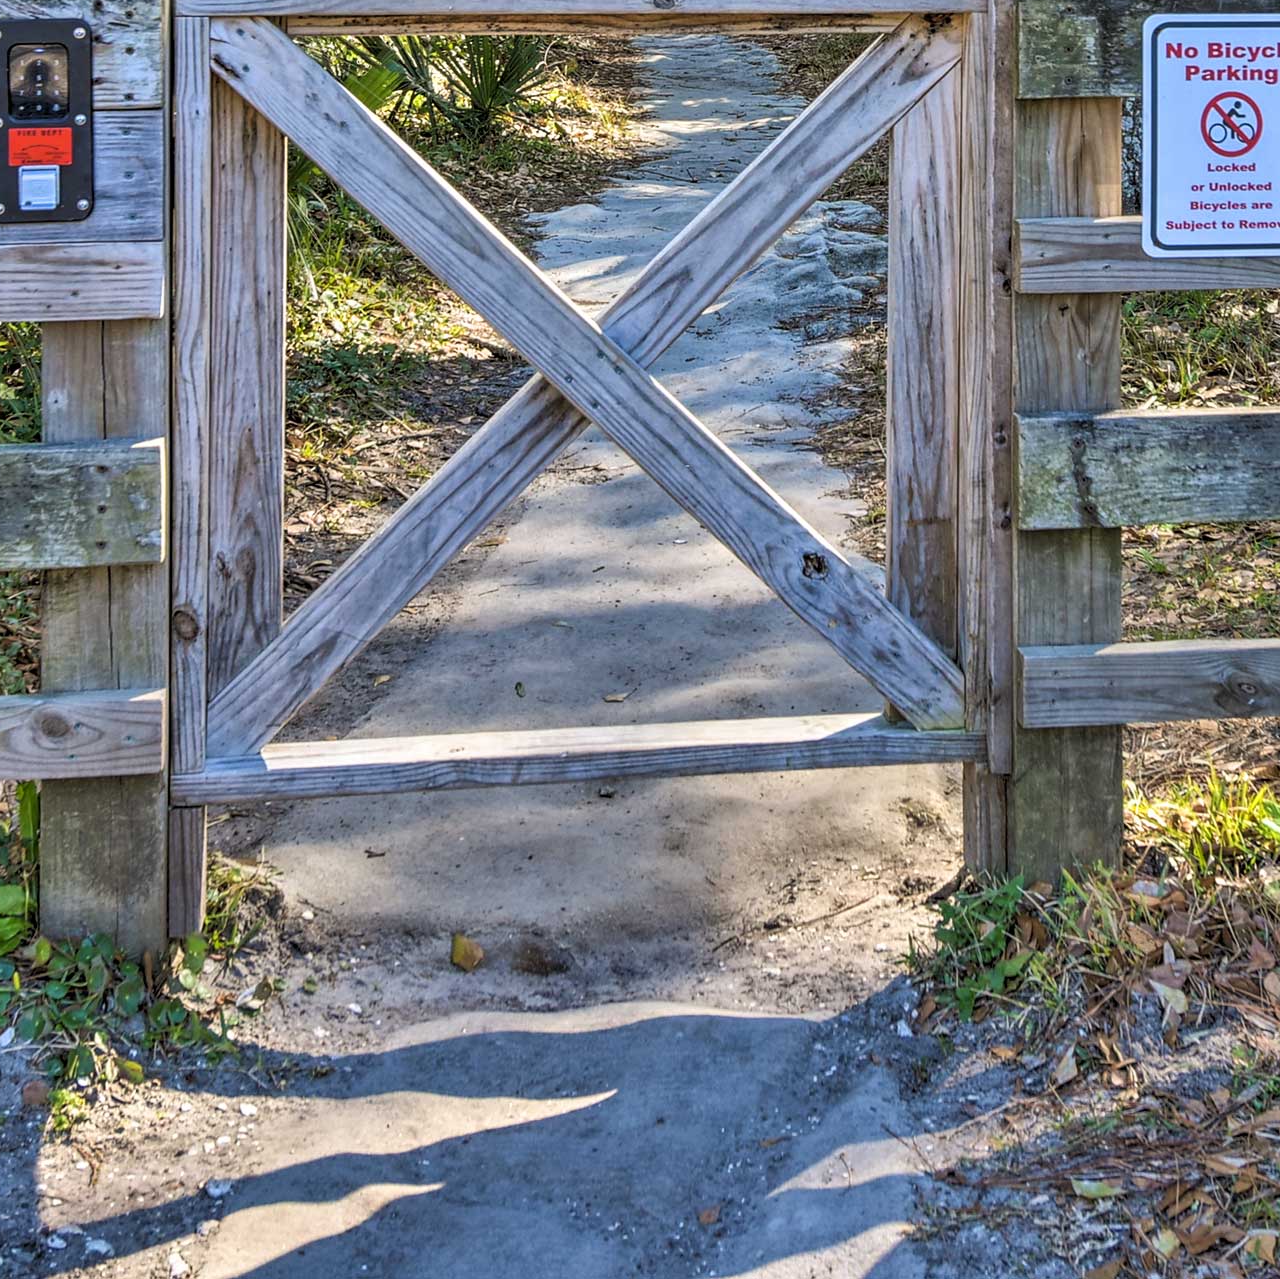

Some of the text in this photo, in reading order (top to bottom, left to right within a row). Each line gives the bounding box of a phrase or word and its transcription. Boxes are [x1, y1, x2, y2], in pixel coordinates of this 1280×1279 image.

[1166, 42, 1199, 59] No
[1185, 64, 1279, 85] Parking
[1207, 163, 1256, 172] Locked
[1191, 182, 1272, 192] or Unlocked
[1190, 201, 1273, 212] Bicycles are
[1166, 220, 1217, 232] Subject
[1221, 221, 1235, 229] to
